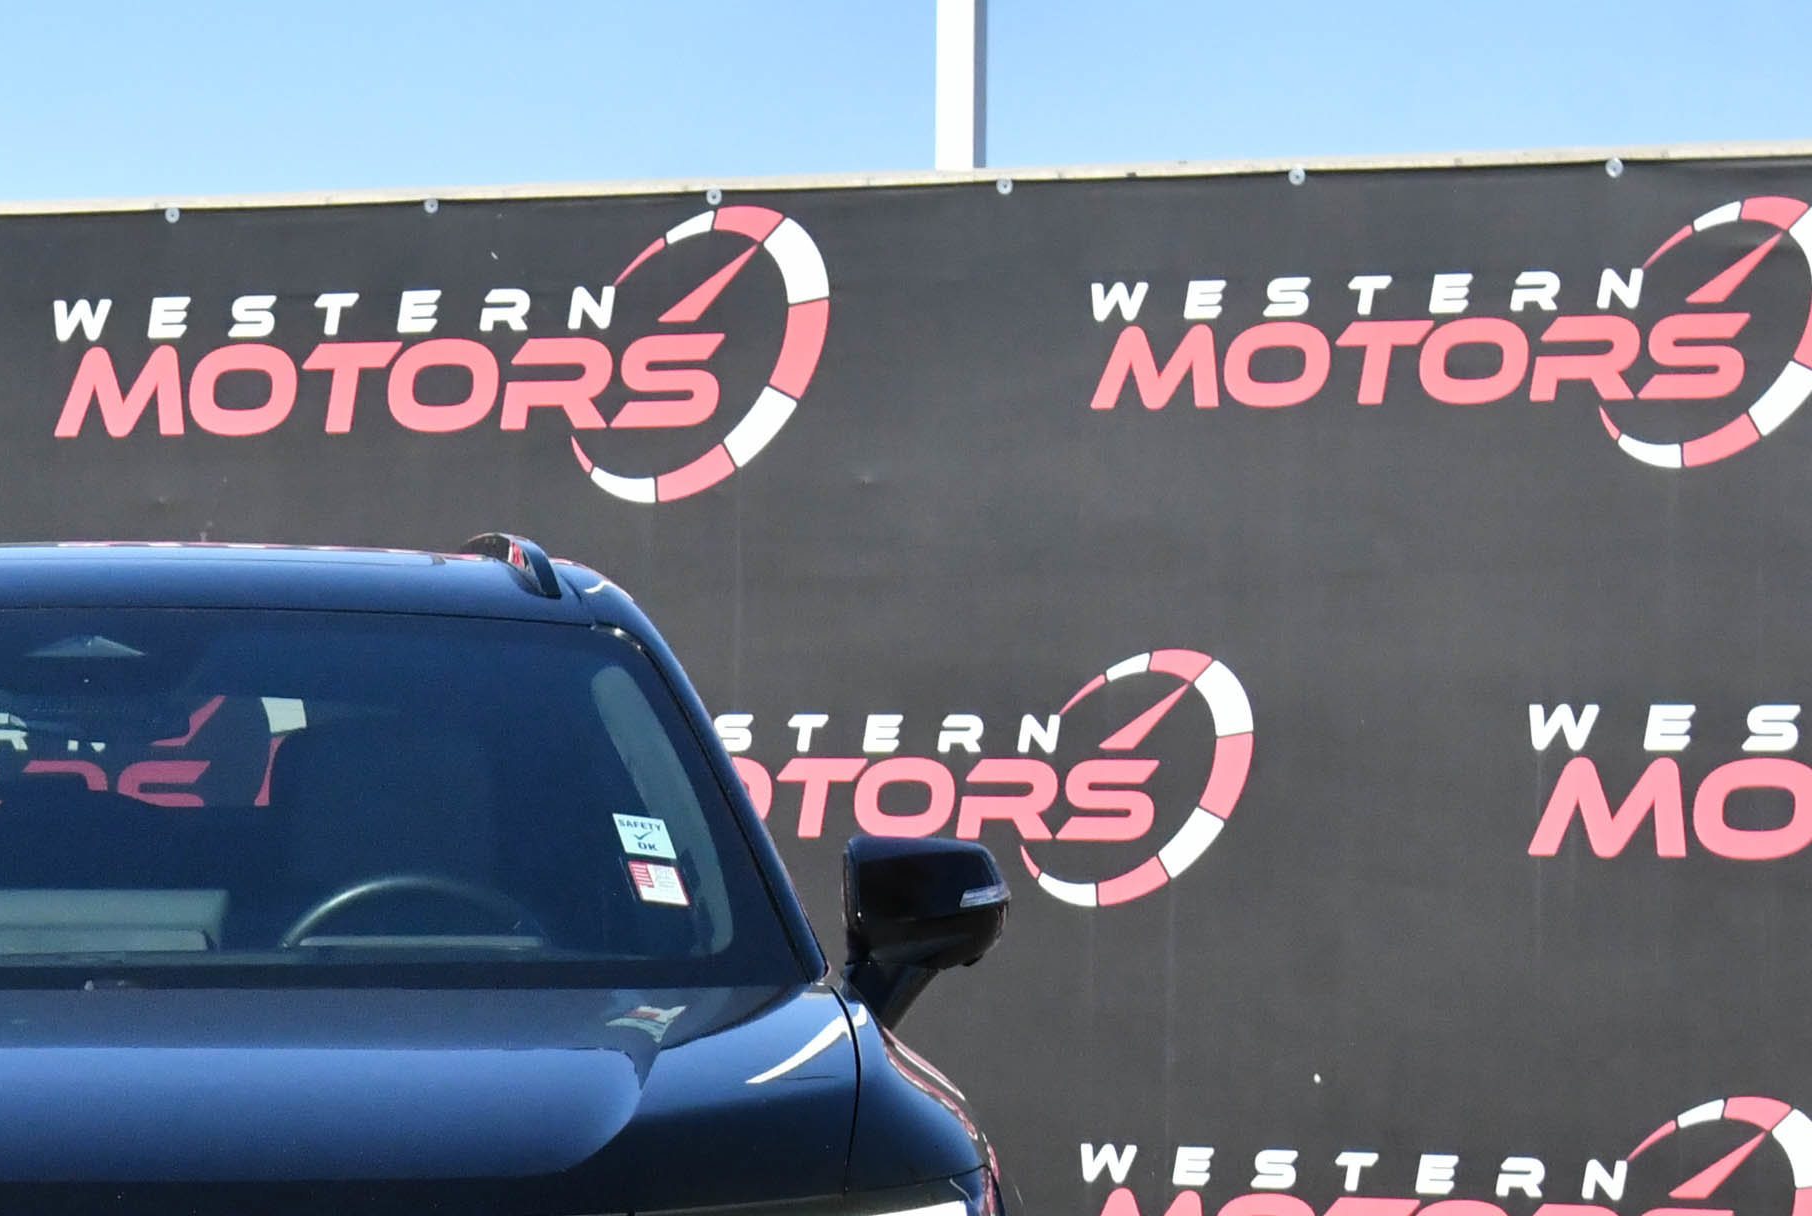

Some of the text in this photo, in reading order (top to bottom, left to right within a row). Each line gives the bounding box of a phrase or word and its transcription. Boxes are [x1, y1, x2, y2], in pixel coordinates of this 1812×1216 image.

[52, 285, 616, 343] WESTERN
[1090, 266, 1644, 323] WESTERN
[53, 332, 728, 440] MOTORS
[1090, 312, 1752, 411] MOTORS
[713, 713, 1061, 755] STERN
[1528, 703, 1802, 752] WES
[618, 819, 662, 831] SAFETY
[1527, 755, 1812, 861] MO
[637, 841, 659, 852] OK
[1080, 1142, 1628, 1202] WESTERN
